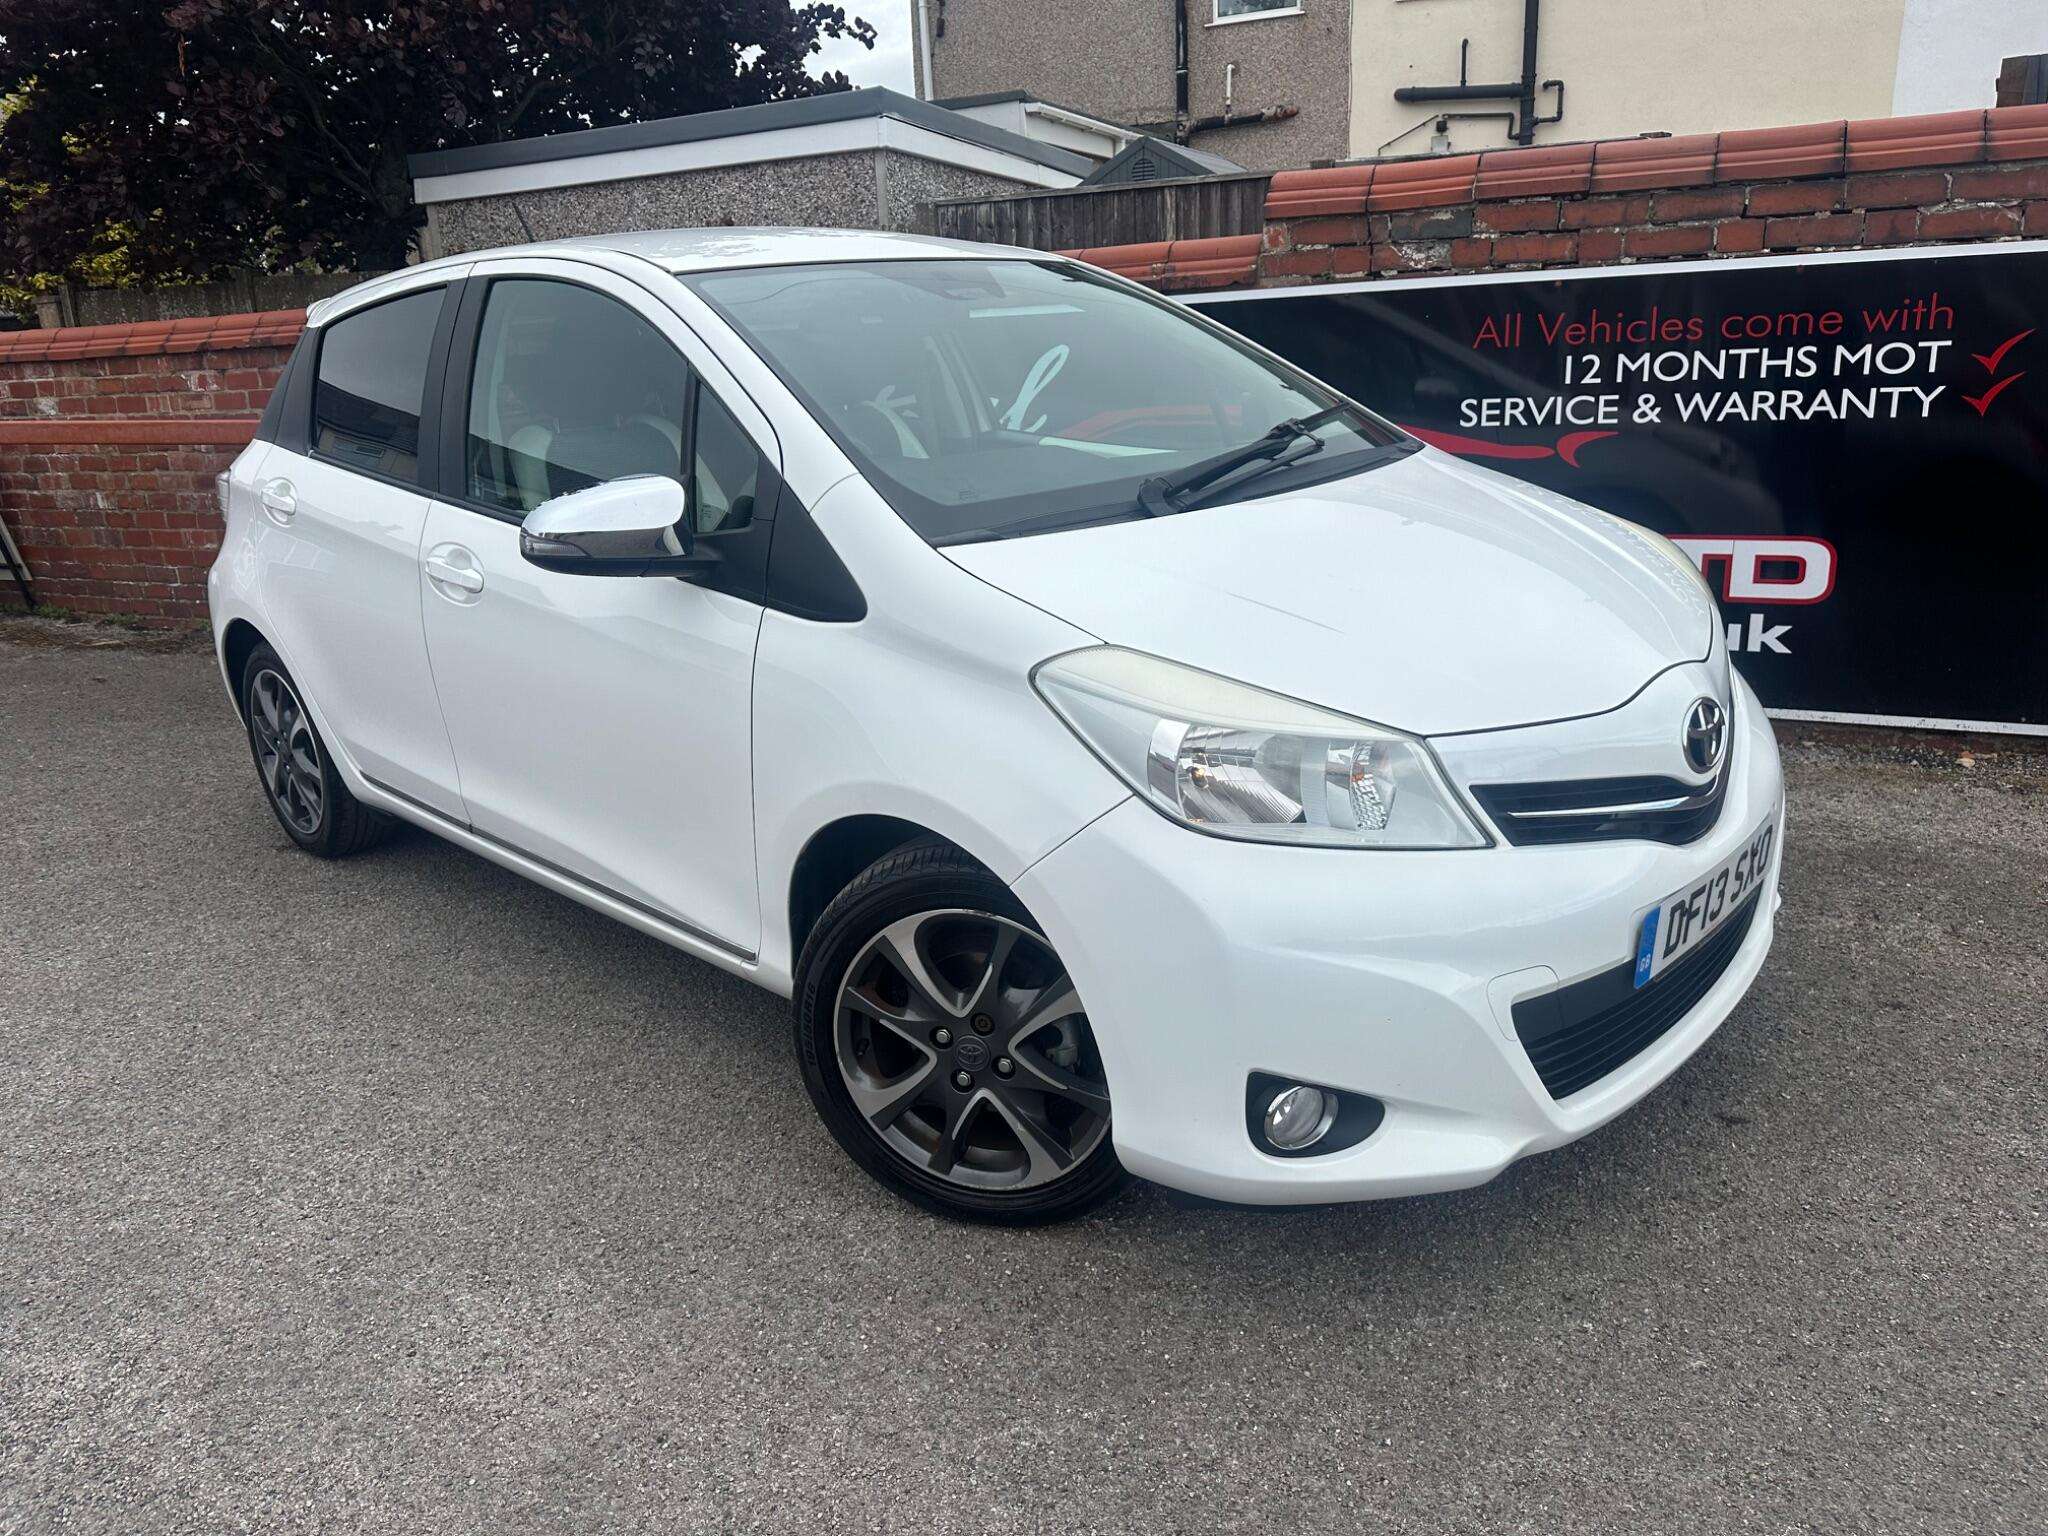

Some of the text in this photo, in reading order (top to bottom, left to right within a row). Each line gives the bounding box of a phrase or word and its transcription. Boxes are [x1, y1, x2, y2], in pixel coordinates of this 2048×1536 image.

[1473, 292, 1954, 349] All Vehicles come with
[1564, 340, 1952, 384] 12 MONTHS MOT
[1459, 385, 1946, 427] SERVICE & WARRANTY
[1663, 867, 1730, 960] DF13
